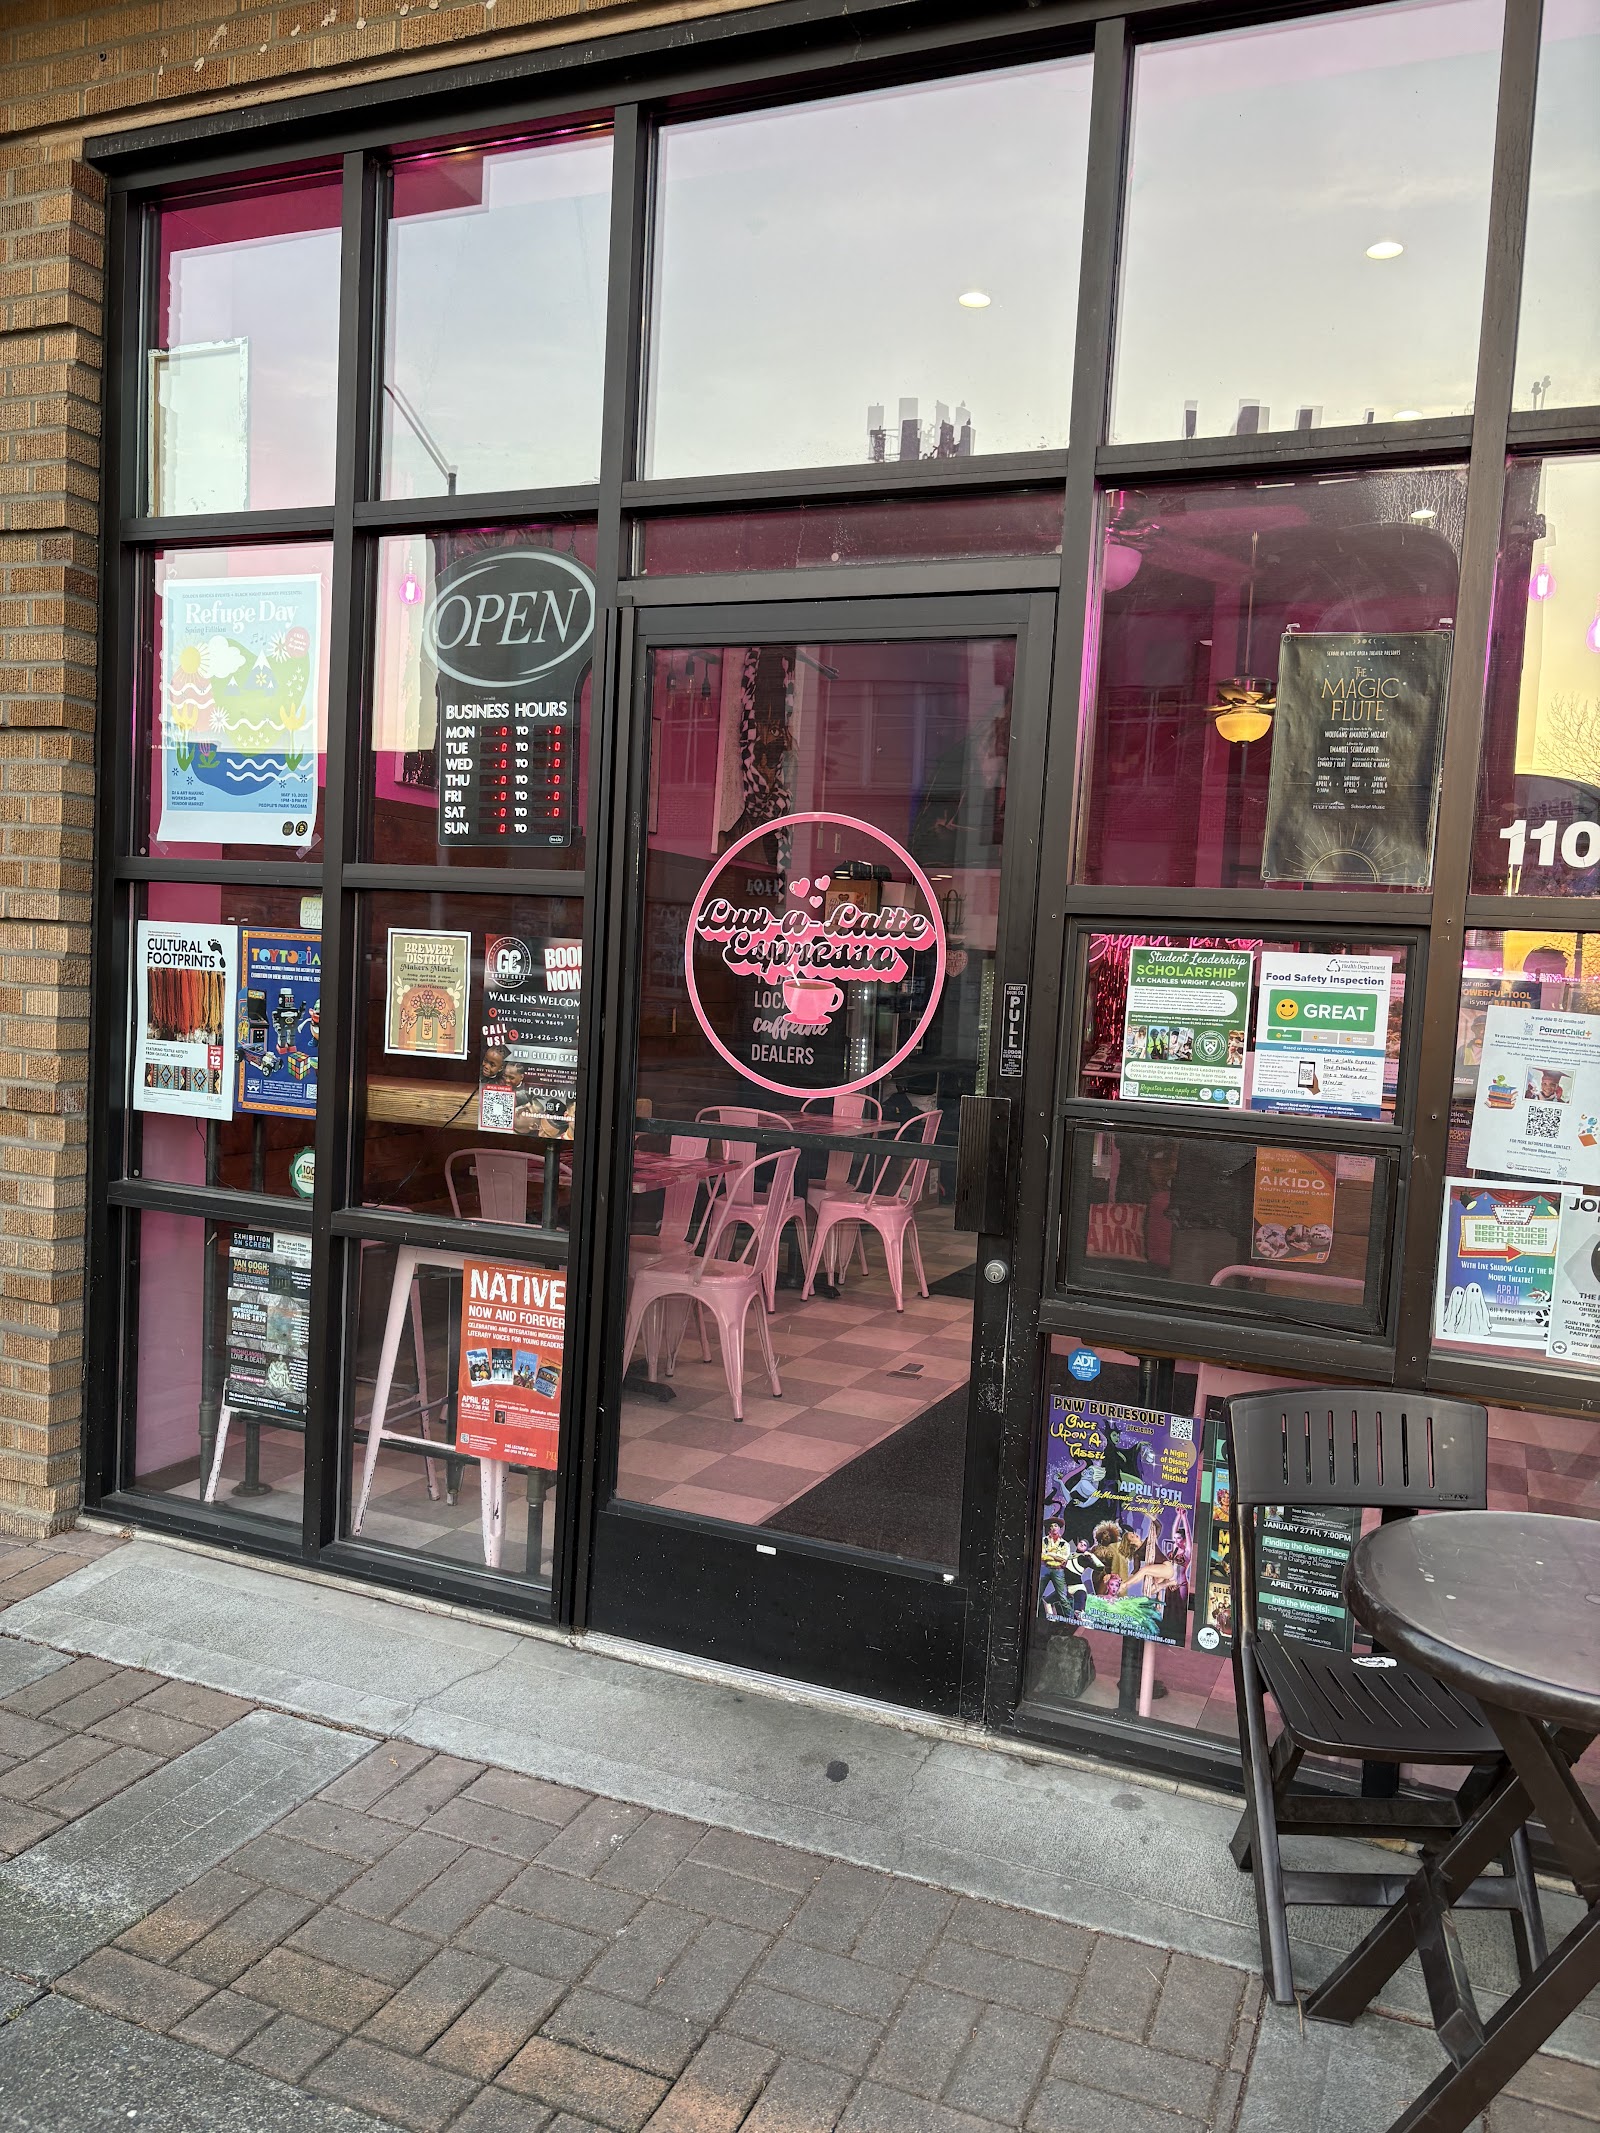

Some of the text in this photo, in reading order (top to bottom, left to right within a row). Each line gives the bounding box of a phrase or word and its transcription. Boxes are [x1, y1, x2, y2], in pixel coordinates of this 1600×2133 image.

[185, 600, 298, 634] Refuge Day
[436, 588, 582, 650] OPEN
[185, 625, 226, 635] Spring Edition
[1354, 666, 1367, 680] THE
[1321, 677, 1400, 699] MAGIC
[446, 701, 567, 719] BUSINESS HOURS
[1331, 700, 1385, 721] FLUTE
[446, 726, 529, 738] MON TO
[445, 742, 529, 754] TUE TO
[445, 758, 529, 770] WED TO
[445, 774, 529, 786] THU TO
[444, 790, 528, 802] FRI TO
[444, 806, 528, 818] SAT TO
[444, 822, 528, 834] SUN TO
[1500, 819, 1600, 869] 110
[147, 938, 203, 953] CULTURAL
[404, 943, 455, 956] BREWERY
[147, 951, 215, 968] FOOTPRINTS
[406, 953, 453, 966] DISTRICT
[722, 931, 905, 980] Espresso
[1148, 951, 1248, 970] Student Leadership
[430, 965, 459, 973] Market
[1136, 964, 1237, 979] SCHOLARSHIP
[1357, 964, 1386, 972] Department
[546, 969, 582, 992] NOW
[1146, 977, 1179, 985] CHARLES
[1180, 978, 1209, 986] WRIGHT
[1210, 980, 1247, 988] ACADEMY
[1266, 972, 1384, 986] Food Safety Inspection
[1462, 988, 1531, 999] OWERFUL TOOL
[1303, 1003, 1369, 1022] GREAT
[1008, 996, 1021, 1048] PULL
[482, 1023, 508, 1036] CALL
[486, 1036, 505, 1047] US!
[520, 1032, 573, 1043] 253-426-5905
[210, 1056, 221, 1065] 12
[513, 1050, 529, 1058] NEW
[532, 1051, 557, 1060] CLIENT
[751, 1043, 814, 1065] DEALERS
[528, 1087, 566, 1098] FOLLOW
[1140, 1083, 1162, 1093] Register
[1257, 1086, 1305, 1096] tpchd.org/rating
[1260, 1175, 1326, 1190] AIKIDO
[1569, 1197, 1600, 1213] JO
[1090, 1203, 1145, 1232] HOT
[234, 1232, 271, 1243] EXHIBITION
[245, 1240, 271, 1249] SCREEN
[233, 1259, 270, 1271] VAN GOGH:
[470, 1268, 566, 1310] NATIVE
[1496, 1284, 1511, 1294] APR
[1579, 1292, 1596, 1300] THE
[1572, 1300, 1594, 1308] MATTER
[233, 1312, 267, 1323] PARIS 1874
[469, 1305, 565, 1330] NOW AND FOREVER
[468, 1322, 498, 1331] CELEBRATING
[509, 1327, 537, 1337] INTEGRATING
[467, 1330, 491, 1339] LITERARY
[493, 1333, 510, 1341] VOICES
[523, 1337, 539, 1346] YOUNG
[540, 1340, 564, 1349] READERS
[249, 1355, 266, 1365] DEATH
[1073, 1355, 1097, 1367] ADT
[461, 1395, 490, 1406] APRIL 29
[1053, 1396, 1165, 1427] PNW BURLESQUE
[1126, 1424, 1155, 1436] presents
[1089, 1433, 1102, 1447] A
[1169, 1449, 1188, 1459] Night
[1162, 1464, 1182, 1474] Magic
[1168, 1457, 1190, 1468] Disney
[1161, 1472, 1188, 1484] Mischief
[1120, 1480, 1182, 1502] APRIL 19TH
[1091, 1490, 1193, 1510] McMenamins Spanish Ballroom
[1149, 1504, 1165, 1515] WA
[1263, 1520, 1351, 1542] JANUARY 27TH, 7:00PM
[1262, 1546, 1288, 1556] Predators,
[1264, 1537, 1349, 1559] Finding the Green Place:
[1288, 1556, 1332, 1569] Changing Climate
[1213, 1586, 1222, 1594] BIG
[1270, 1580, 1339, 1599] APRIL 7TH, 7:00PM
[1271, 1595, 1331, 1614] Into the Weed(s):
[1267, 1604, 1336, 1623] Clarifying Cannabis Science
[1282, 1612, 1320, 1625] Misconceptions
